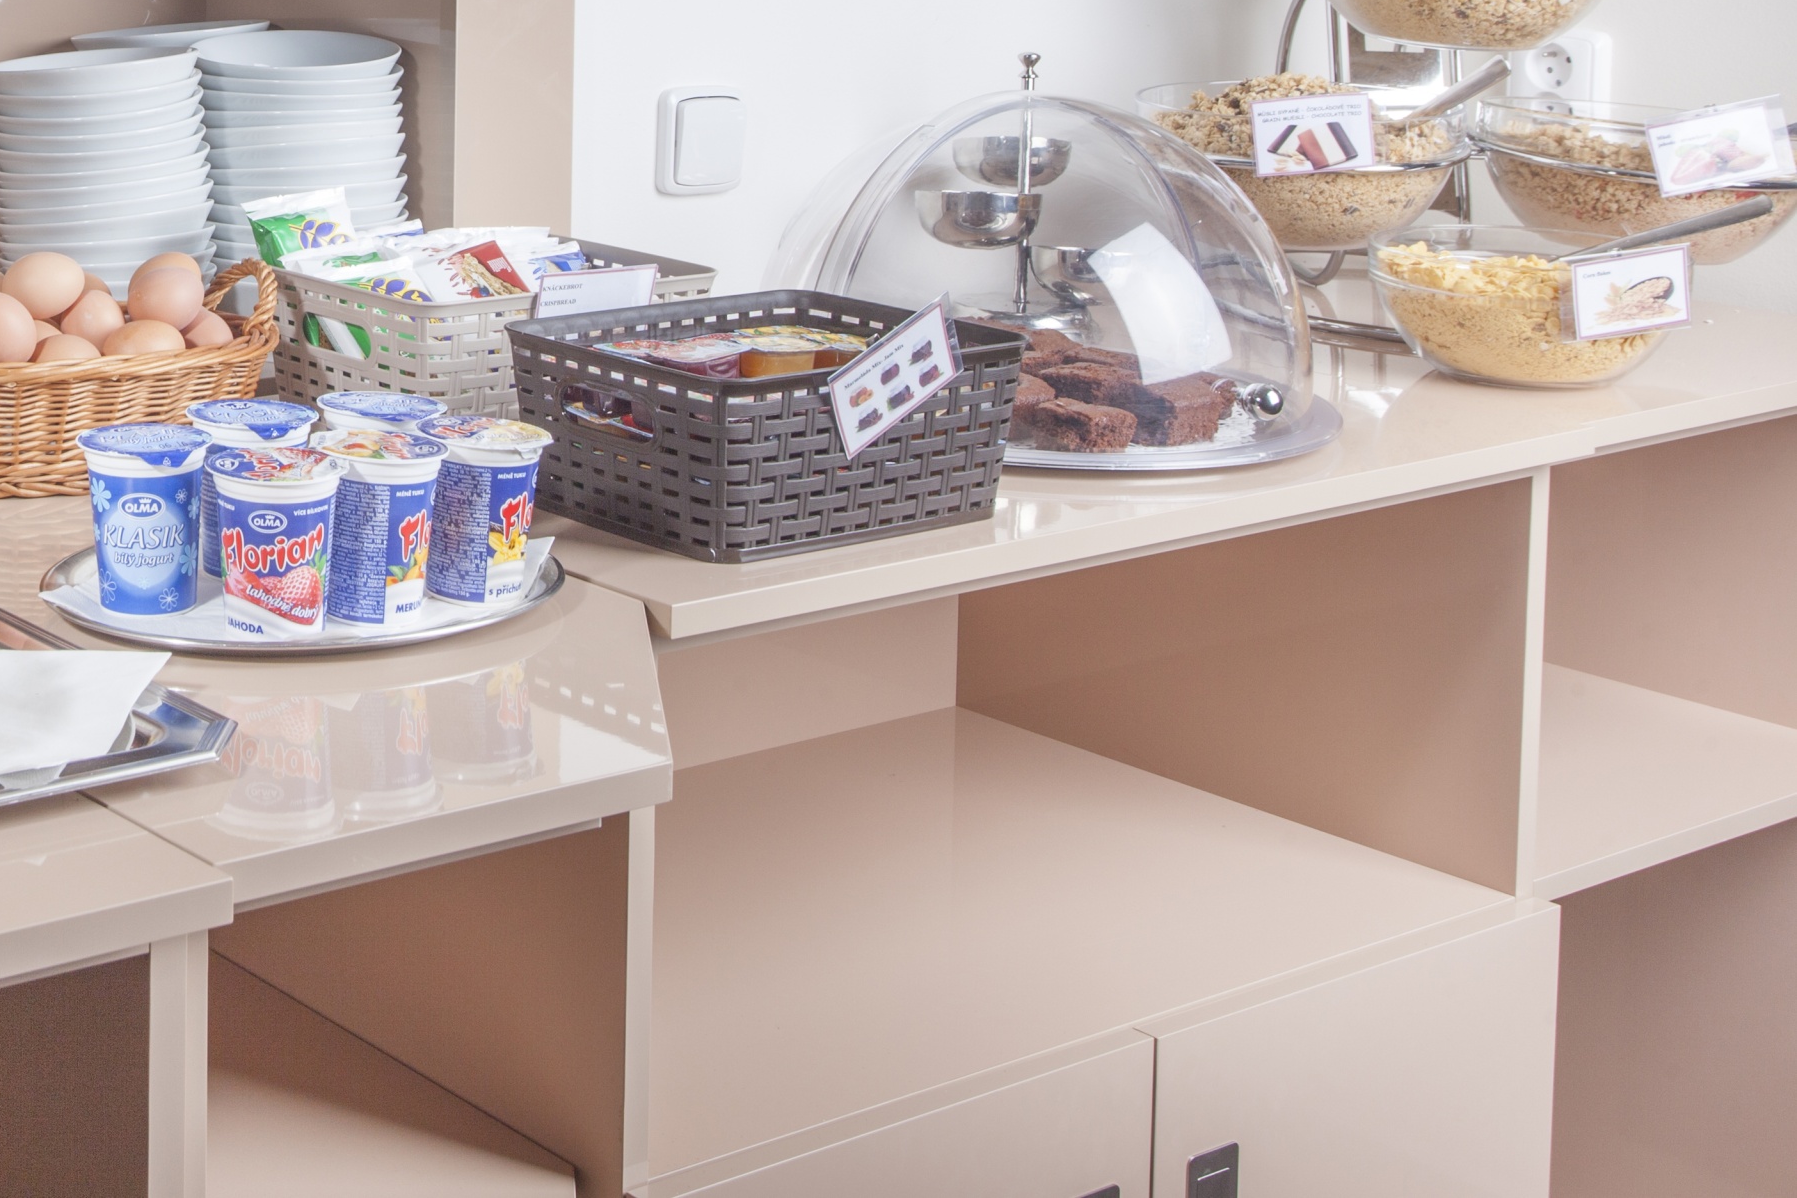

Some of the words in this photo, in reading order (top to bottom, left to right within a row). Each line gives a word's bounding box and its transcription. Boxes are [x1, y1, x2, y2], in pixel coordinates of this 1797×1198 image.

[1311, 111, 1344, 119] CHOCOLATE
[539, 298, 577, 307] CRISPBREAD
[124, 503, 159, 513] OLMA
[293, 509, 307, 517] VÍCE
[253, 518, 281, 527] OLMA
[103, 523, 185, 550] KLASIK
[221, 522, 325, 575] Florian
[114, 551, 136, 567] bílý
[137, 552, 174, 568] jogurt
[245, 584, 293, 613] lahodně
